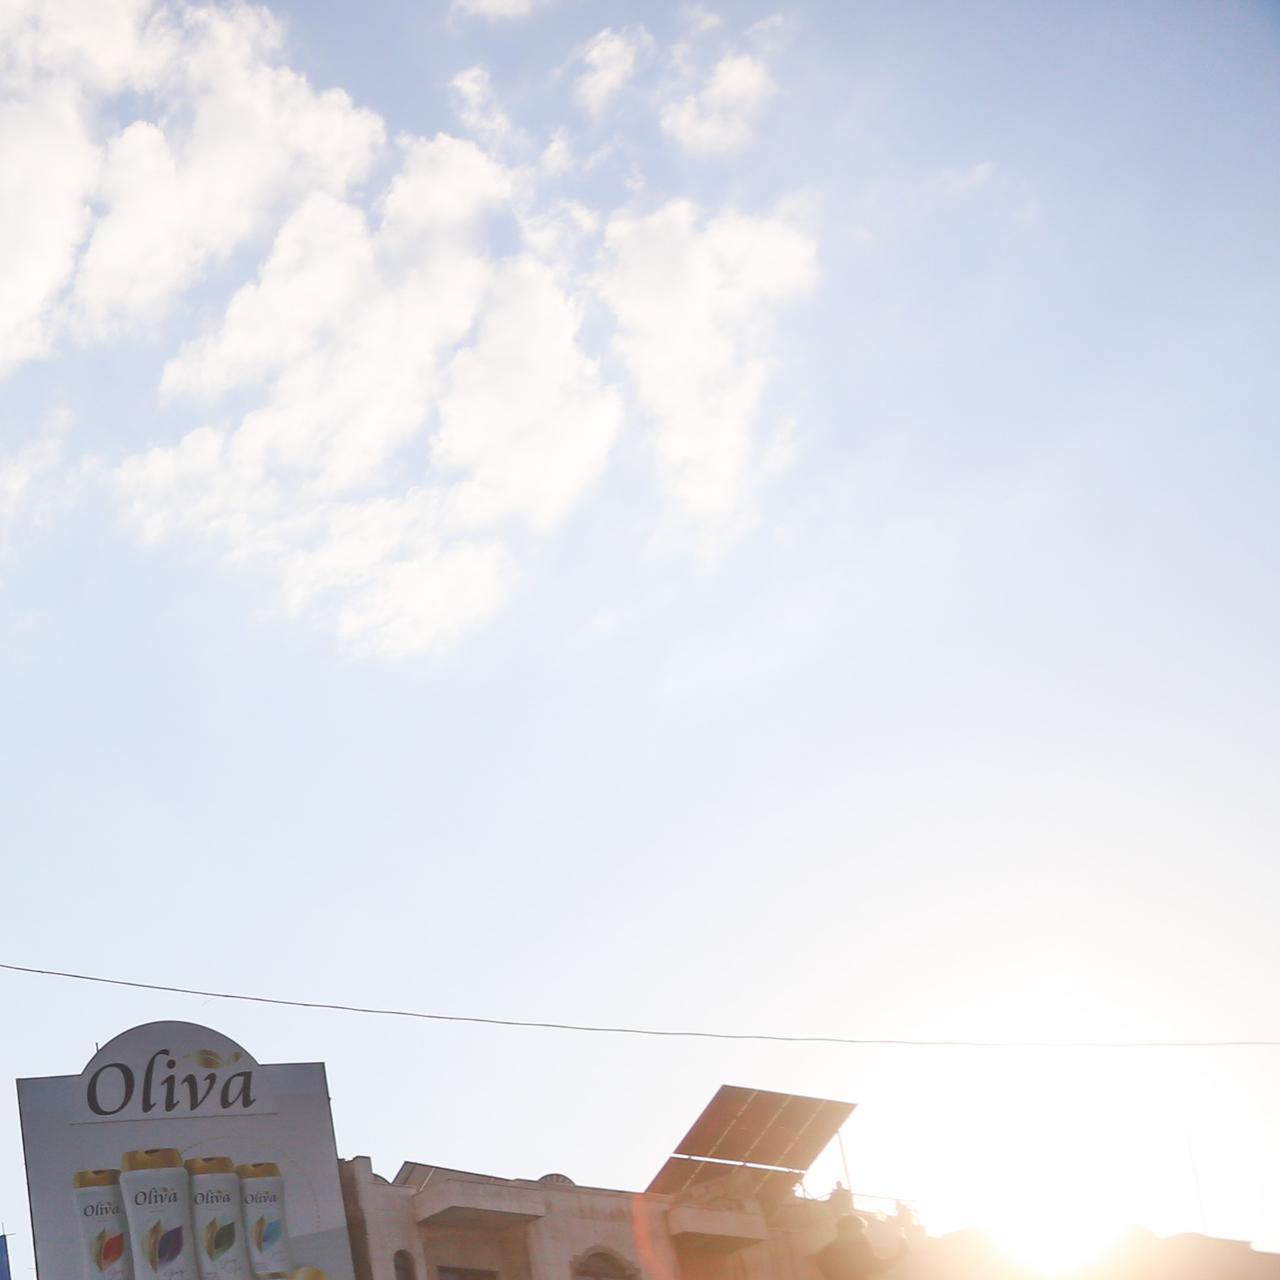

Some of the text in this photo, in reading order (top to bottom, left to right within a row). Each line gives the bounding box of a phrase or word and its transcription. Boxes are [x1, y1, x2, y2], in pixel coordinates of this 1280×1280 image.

[86, 1048, 257, 1117] Oliva
[134, 1187, 179, 1206] Oliva
[193, 1189, 232, 1206] Oliva
[244, 1190, 278, 1205] Oliva
[83, 1201, 121, 1217] Oliva
